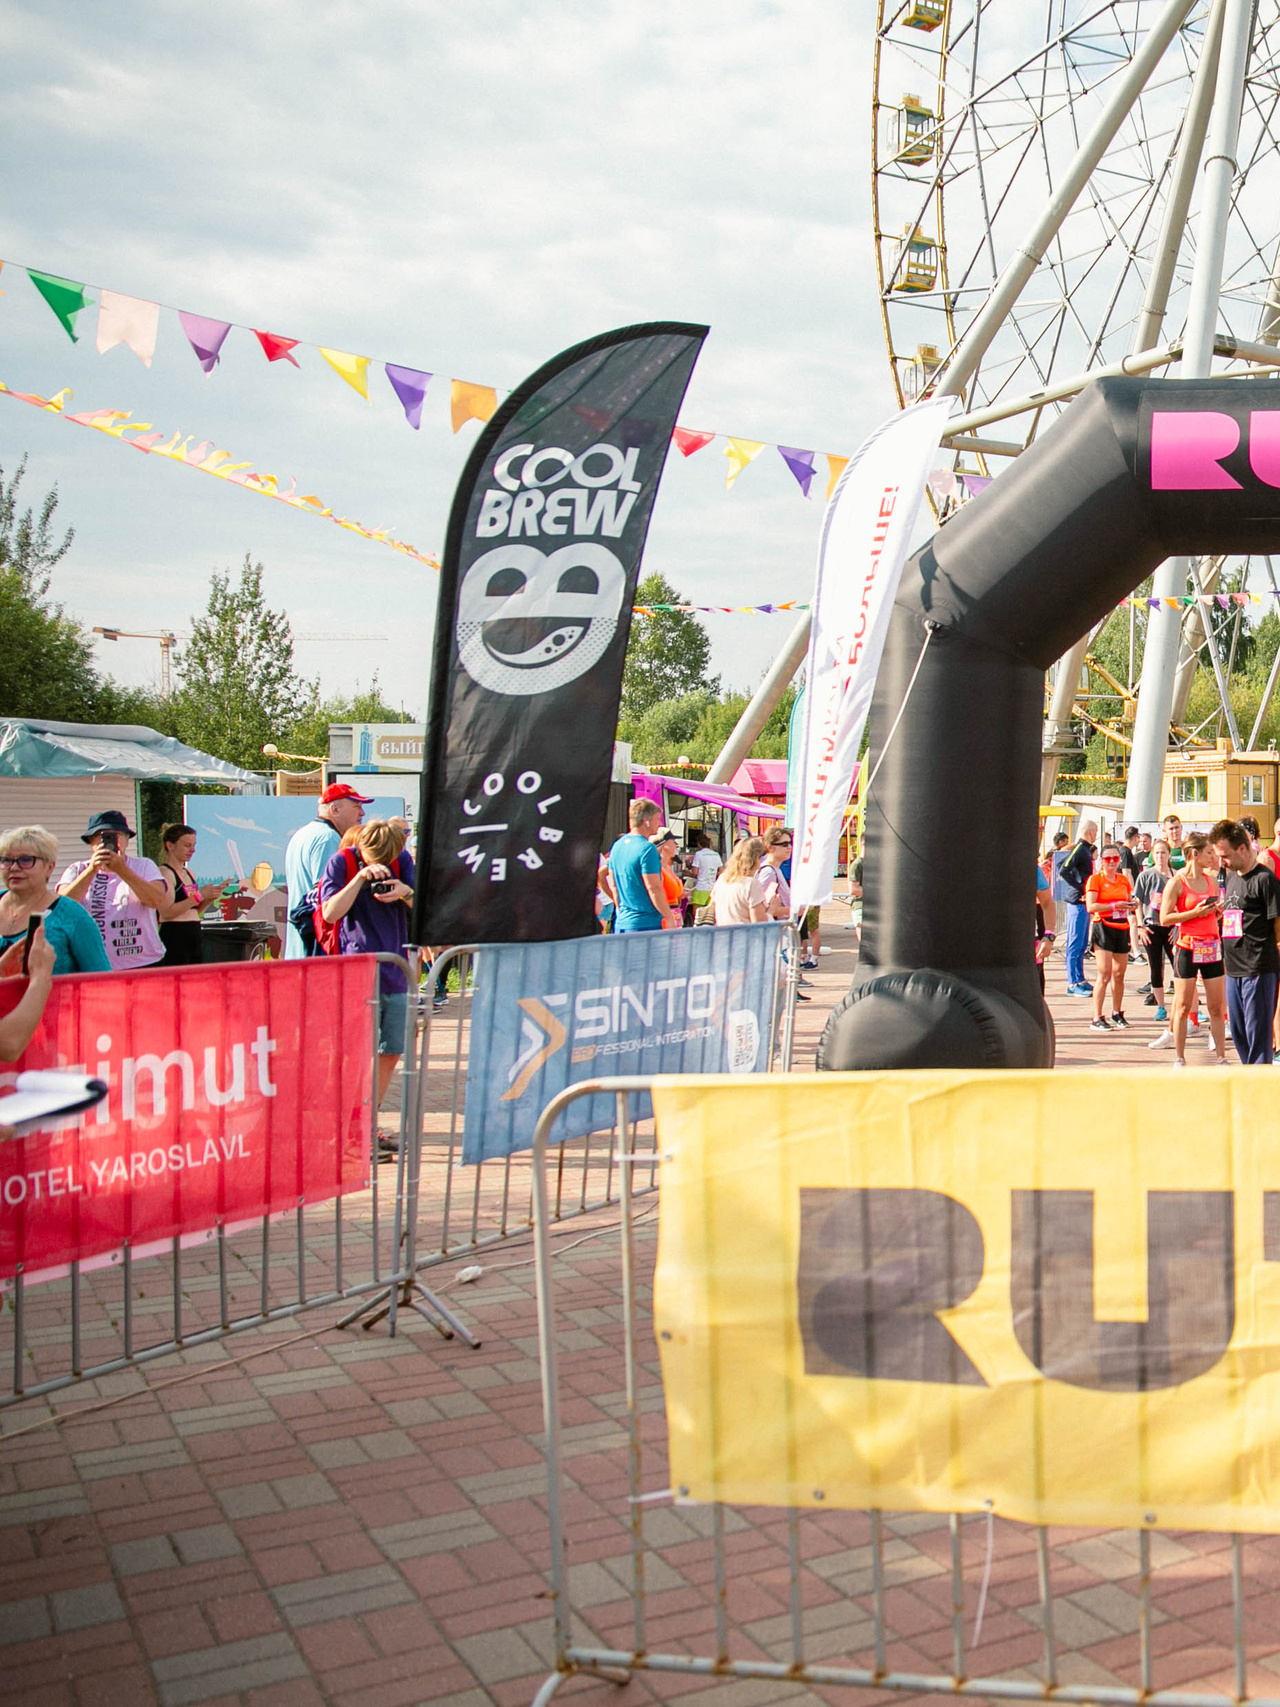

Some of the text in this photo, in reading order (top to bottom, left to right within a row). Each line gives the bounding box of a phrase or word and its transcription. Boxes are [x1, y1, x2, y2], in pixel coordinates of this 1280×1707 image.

[493, 443, 642, 493] COOL
[475, 488, 639, 538] BREW
[575, 974, 716, 1039] SINTO
[14, 1026, 277, 1137] imut
[3, 1133, 250, 1205] OTEL YAROSLAVL
